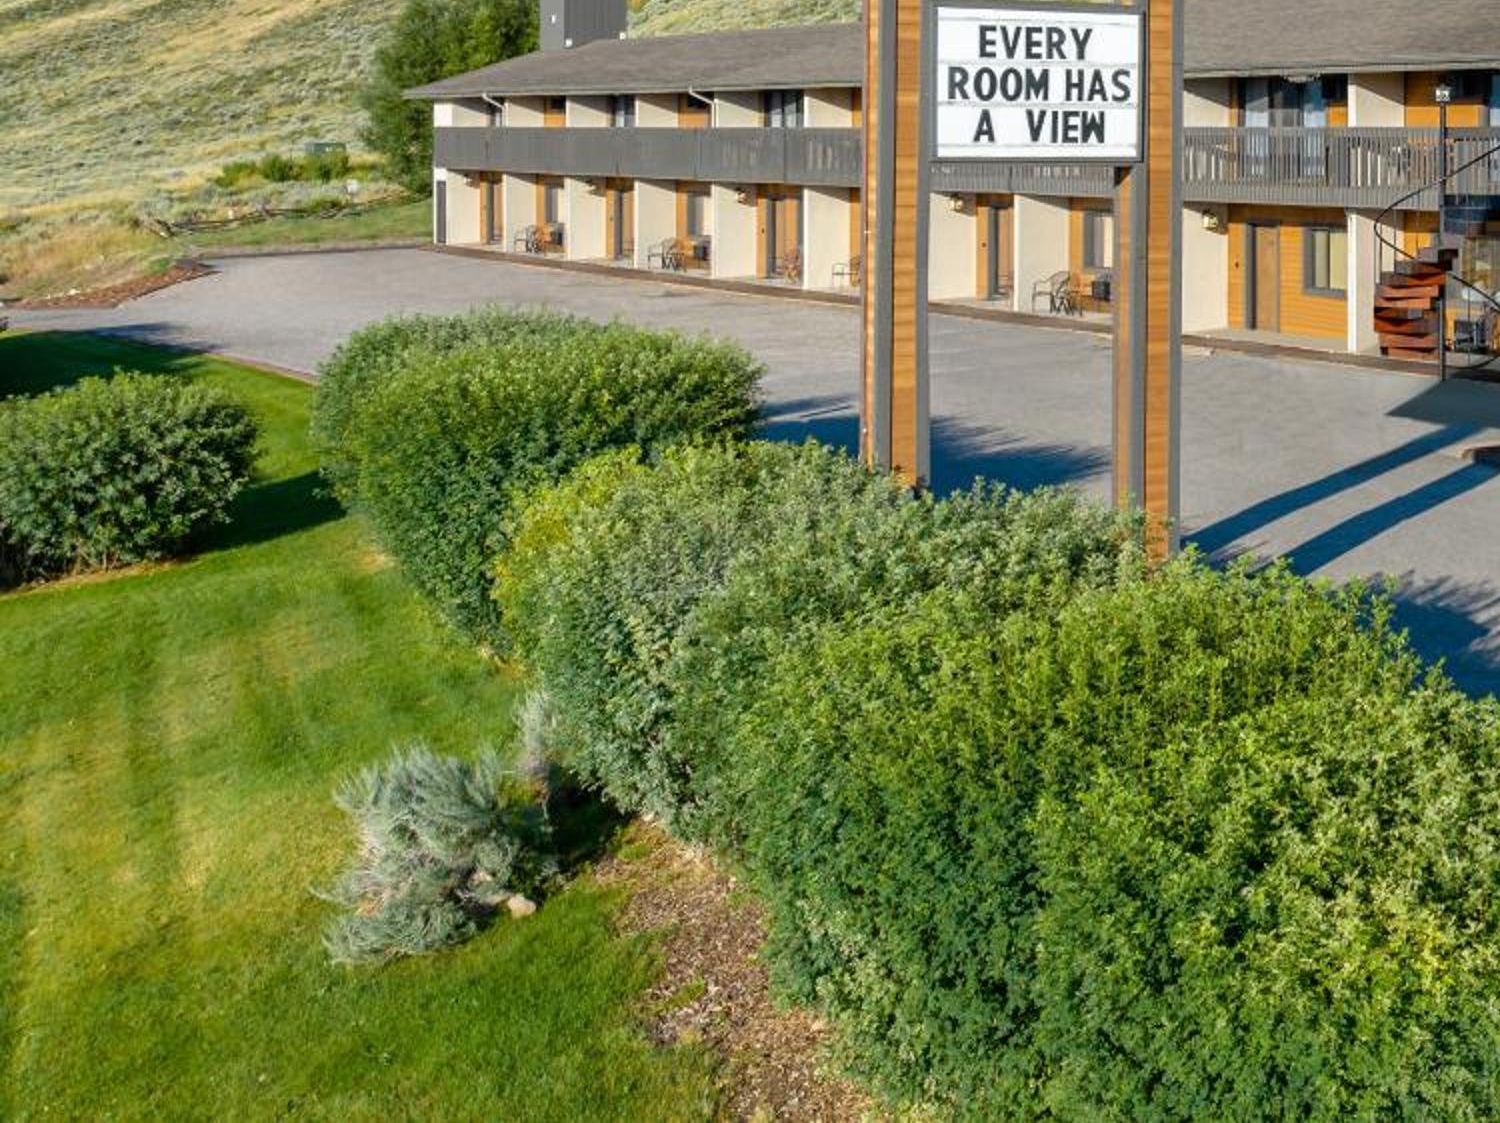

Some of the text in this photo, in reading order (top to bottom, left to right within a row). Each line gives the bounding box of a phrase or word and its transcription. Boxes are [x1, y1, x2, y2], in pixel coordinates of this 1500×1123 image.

[978, 24, 1093, 60] EVERY
[947, 66, 1131, 102] ROOM HAS
[973, 109, 1105, 144] A VIEW
